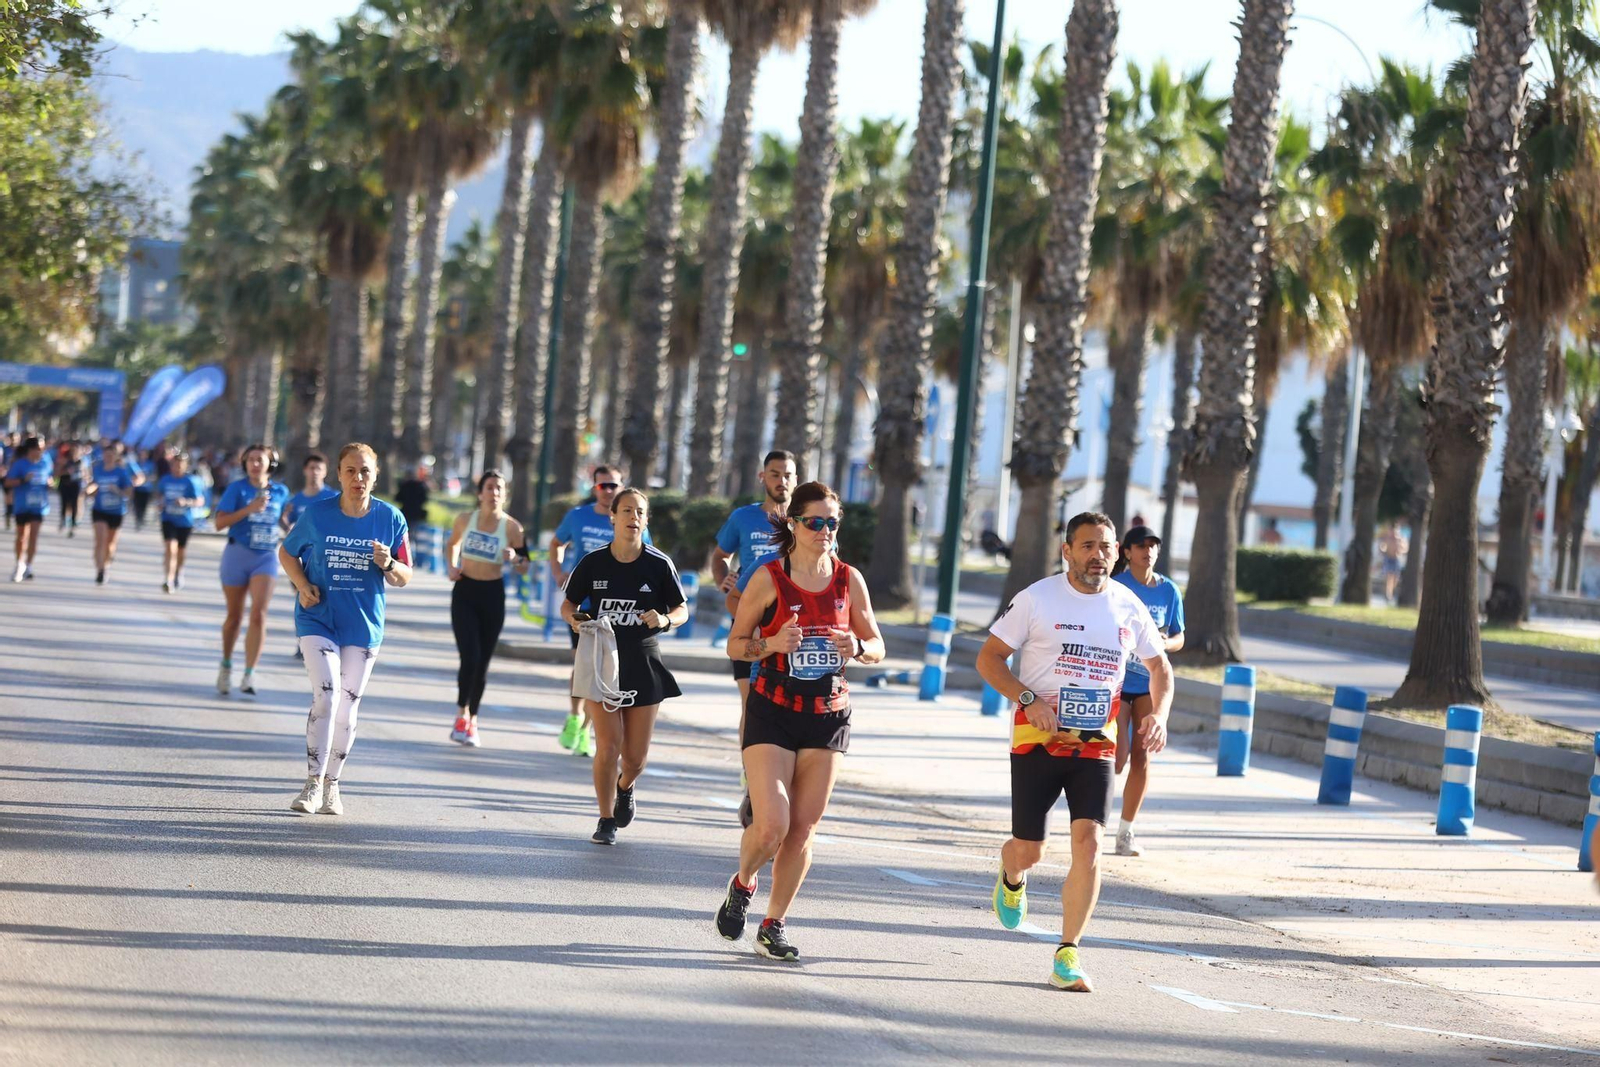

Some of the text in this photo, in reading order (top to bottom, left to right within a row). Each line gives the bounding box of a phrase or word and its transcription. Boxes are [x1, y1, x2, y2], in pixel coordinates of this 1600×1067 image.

[601, 600, 633, 611] UNI
[1061, 643, 1084, 656] XIII
[1084, 645, 1122, 656] CAMPEONATO
[797, 653, 838, 665] 1695
[1058, 655, 1087, 665] CLUBES
[1083, 651, 1119, 663] DE ESPAÑA
[1065, 703, 1105, 715] 2048
